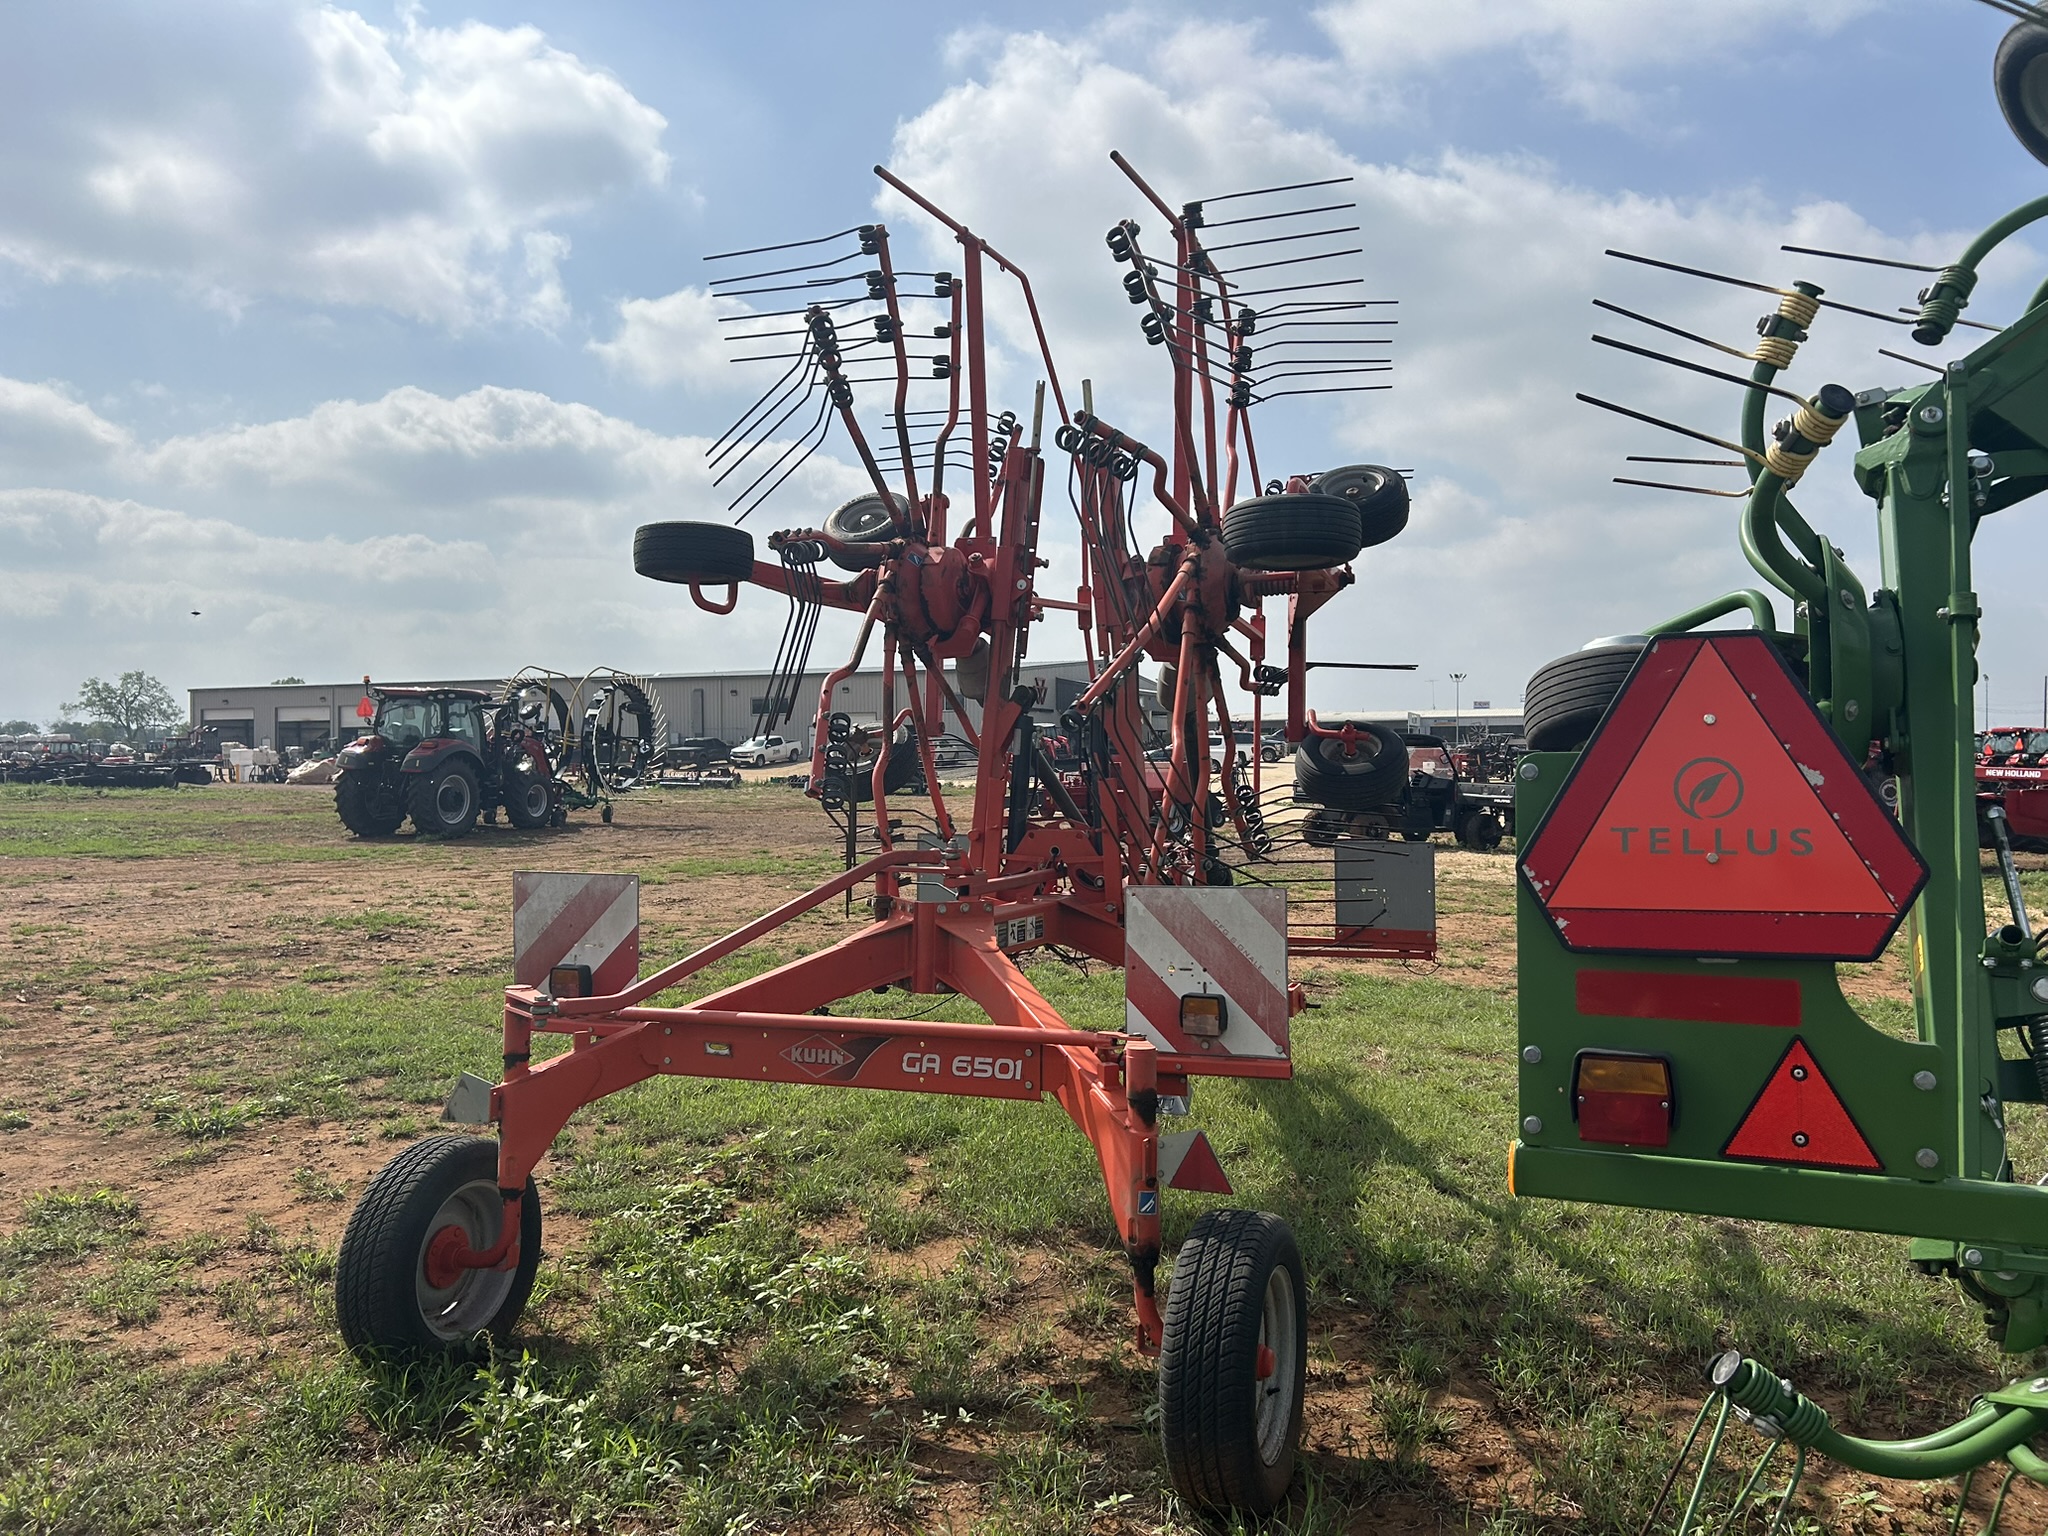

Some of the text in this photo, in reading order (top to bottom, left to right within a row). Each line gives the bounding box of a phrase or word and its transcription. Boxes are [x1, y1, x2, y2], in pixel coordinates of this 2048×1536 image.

[1985, 769, 2041, 778] NEW HOLLAND
[1610, 827, 1814, 856] TELLUS
[790, 1047, 844, 1065] KUHN
[902, 1052, 1023, 1080] GA 6501
